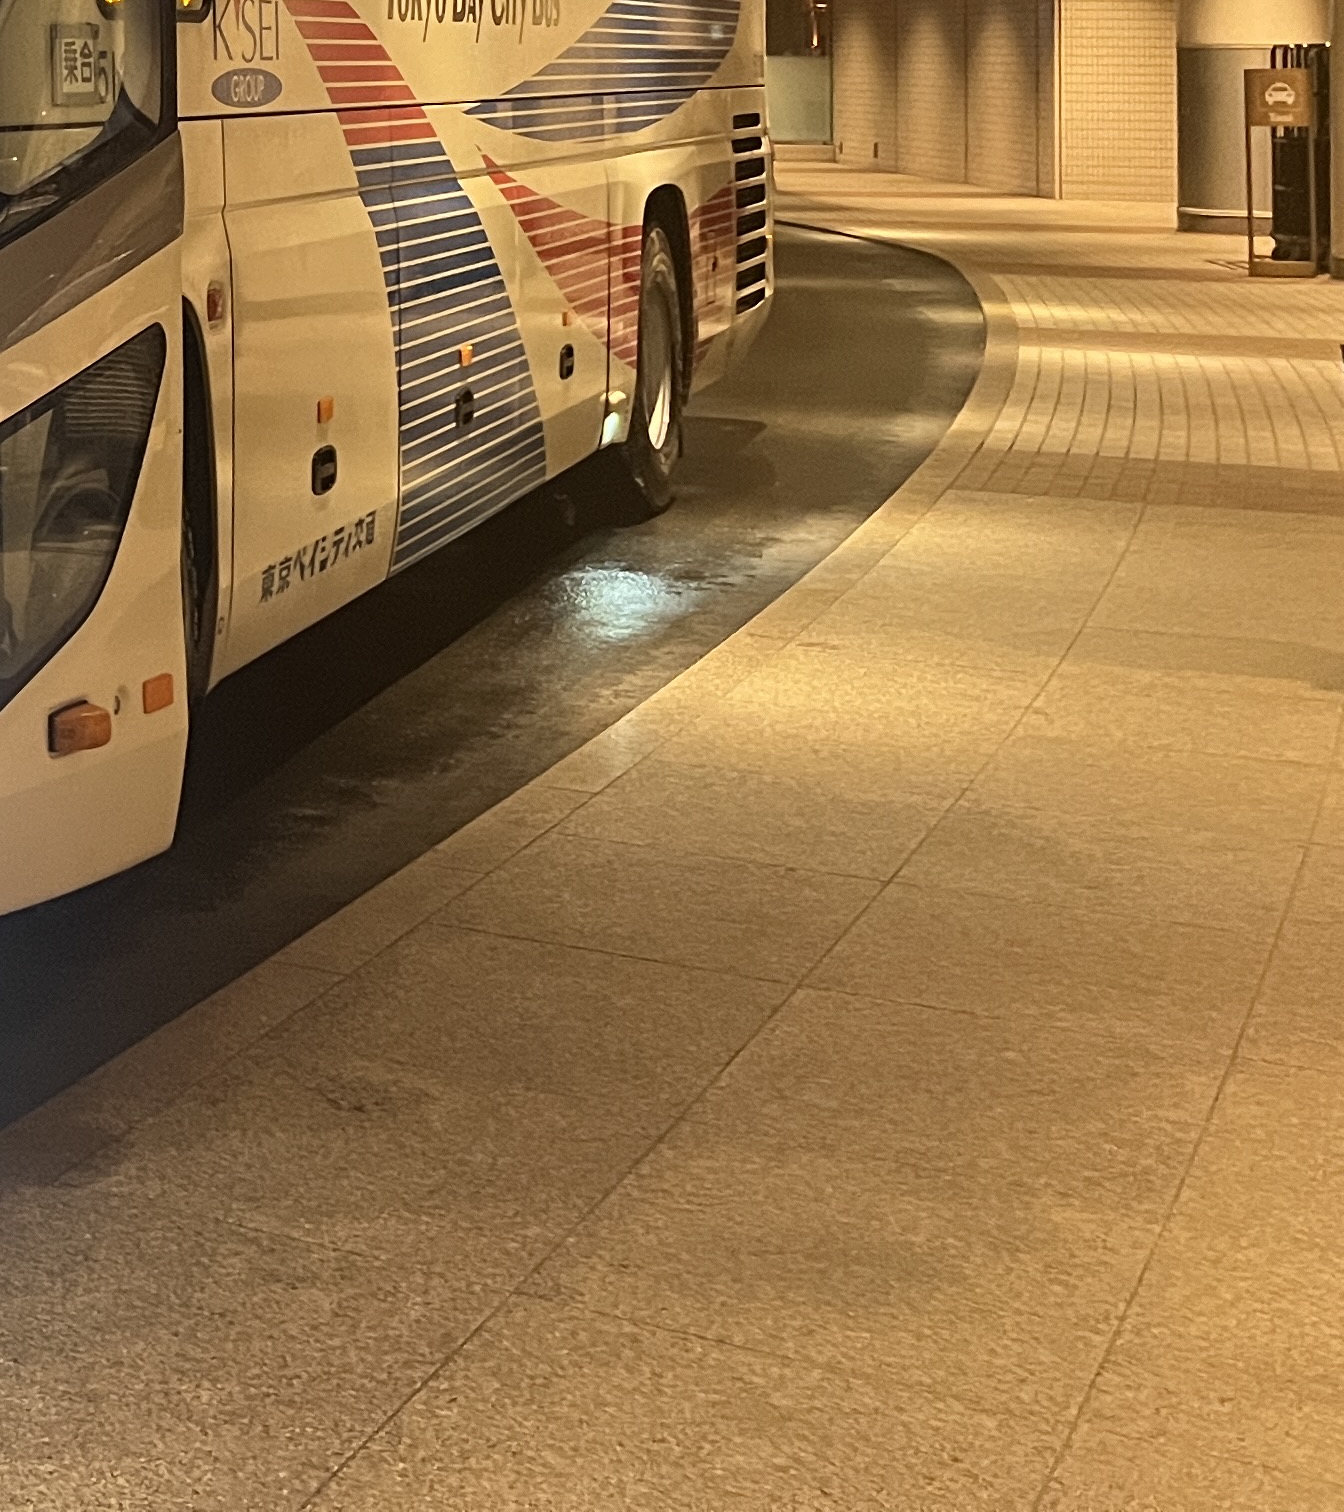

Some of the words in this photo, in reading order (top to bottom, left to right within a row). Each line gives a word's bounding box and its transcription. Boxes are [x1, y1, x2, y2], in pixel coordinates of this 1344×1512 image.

[64, 41, 93, 85] 乗合
[231, 74, 265, 103] GROUP
[259, 508, 378, 604] 東京ベイシティ交通
